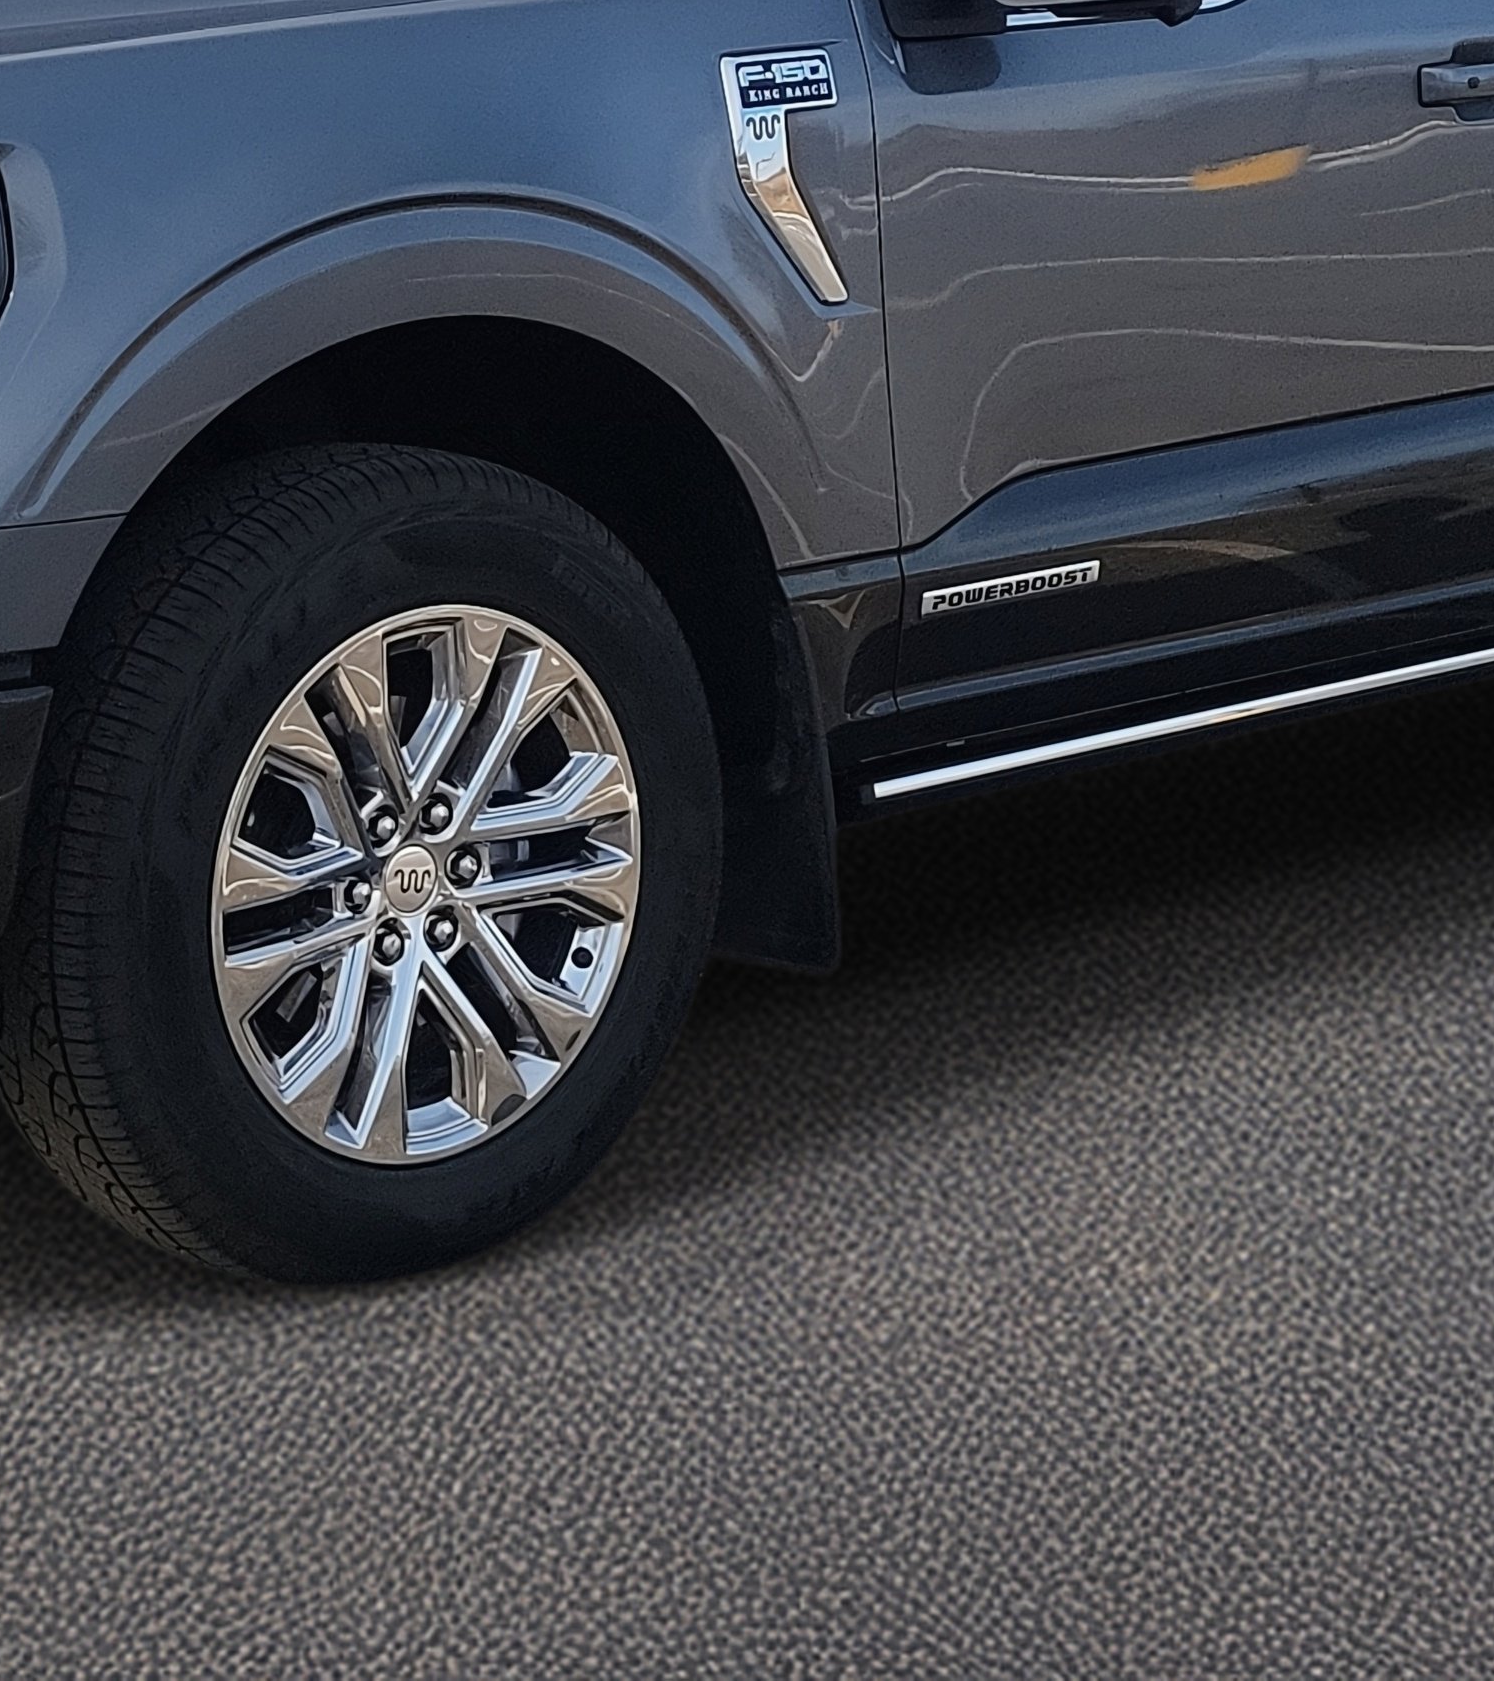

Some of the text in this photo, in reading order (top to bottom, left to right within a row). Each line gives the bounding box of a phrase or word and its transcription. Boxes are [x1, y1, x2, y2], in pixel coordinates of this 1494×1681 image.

[737, 58, 829, 88] F-150
[748, 82, 829, 103] KING RANCH
[932, 567, 1093, 611] POWERBOOST
